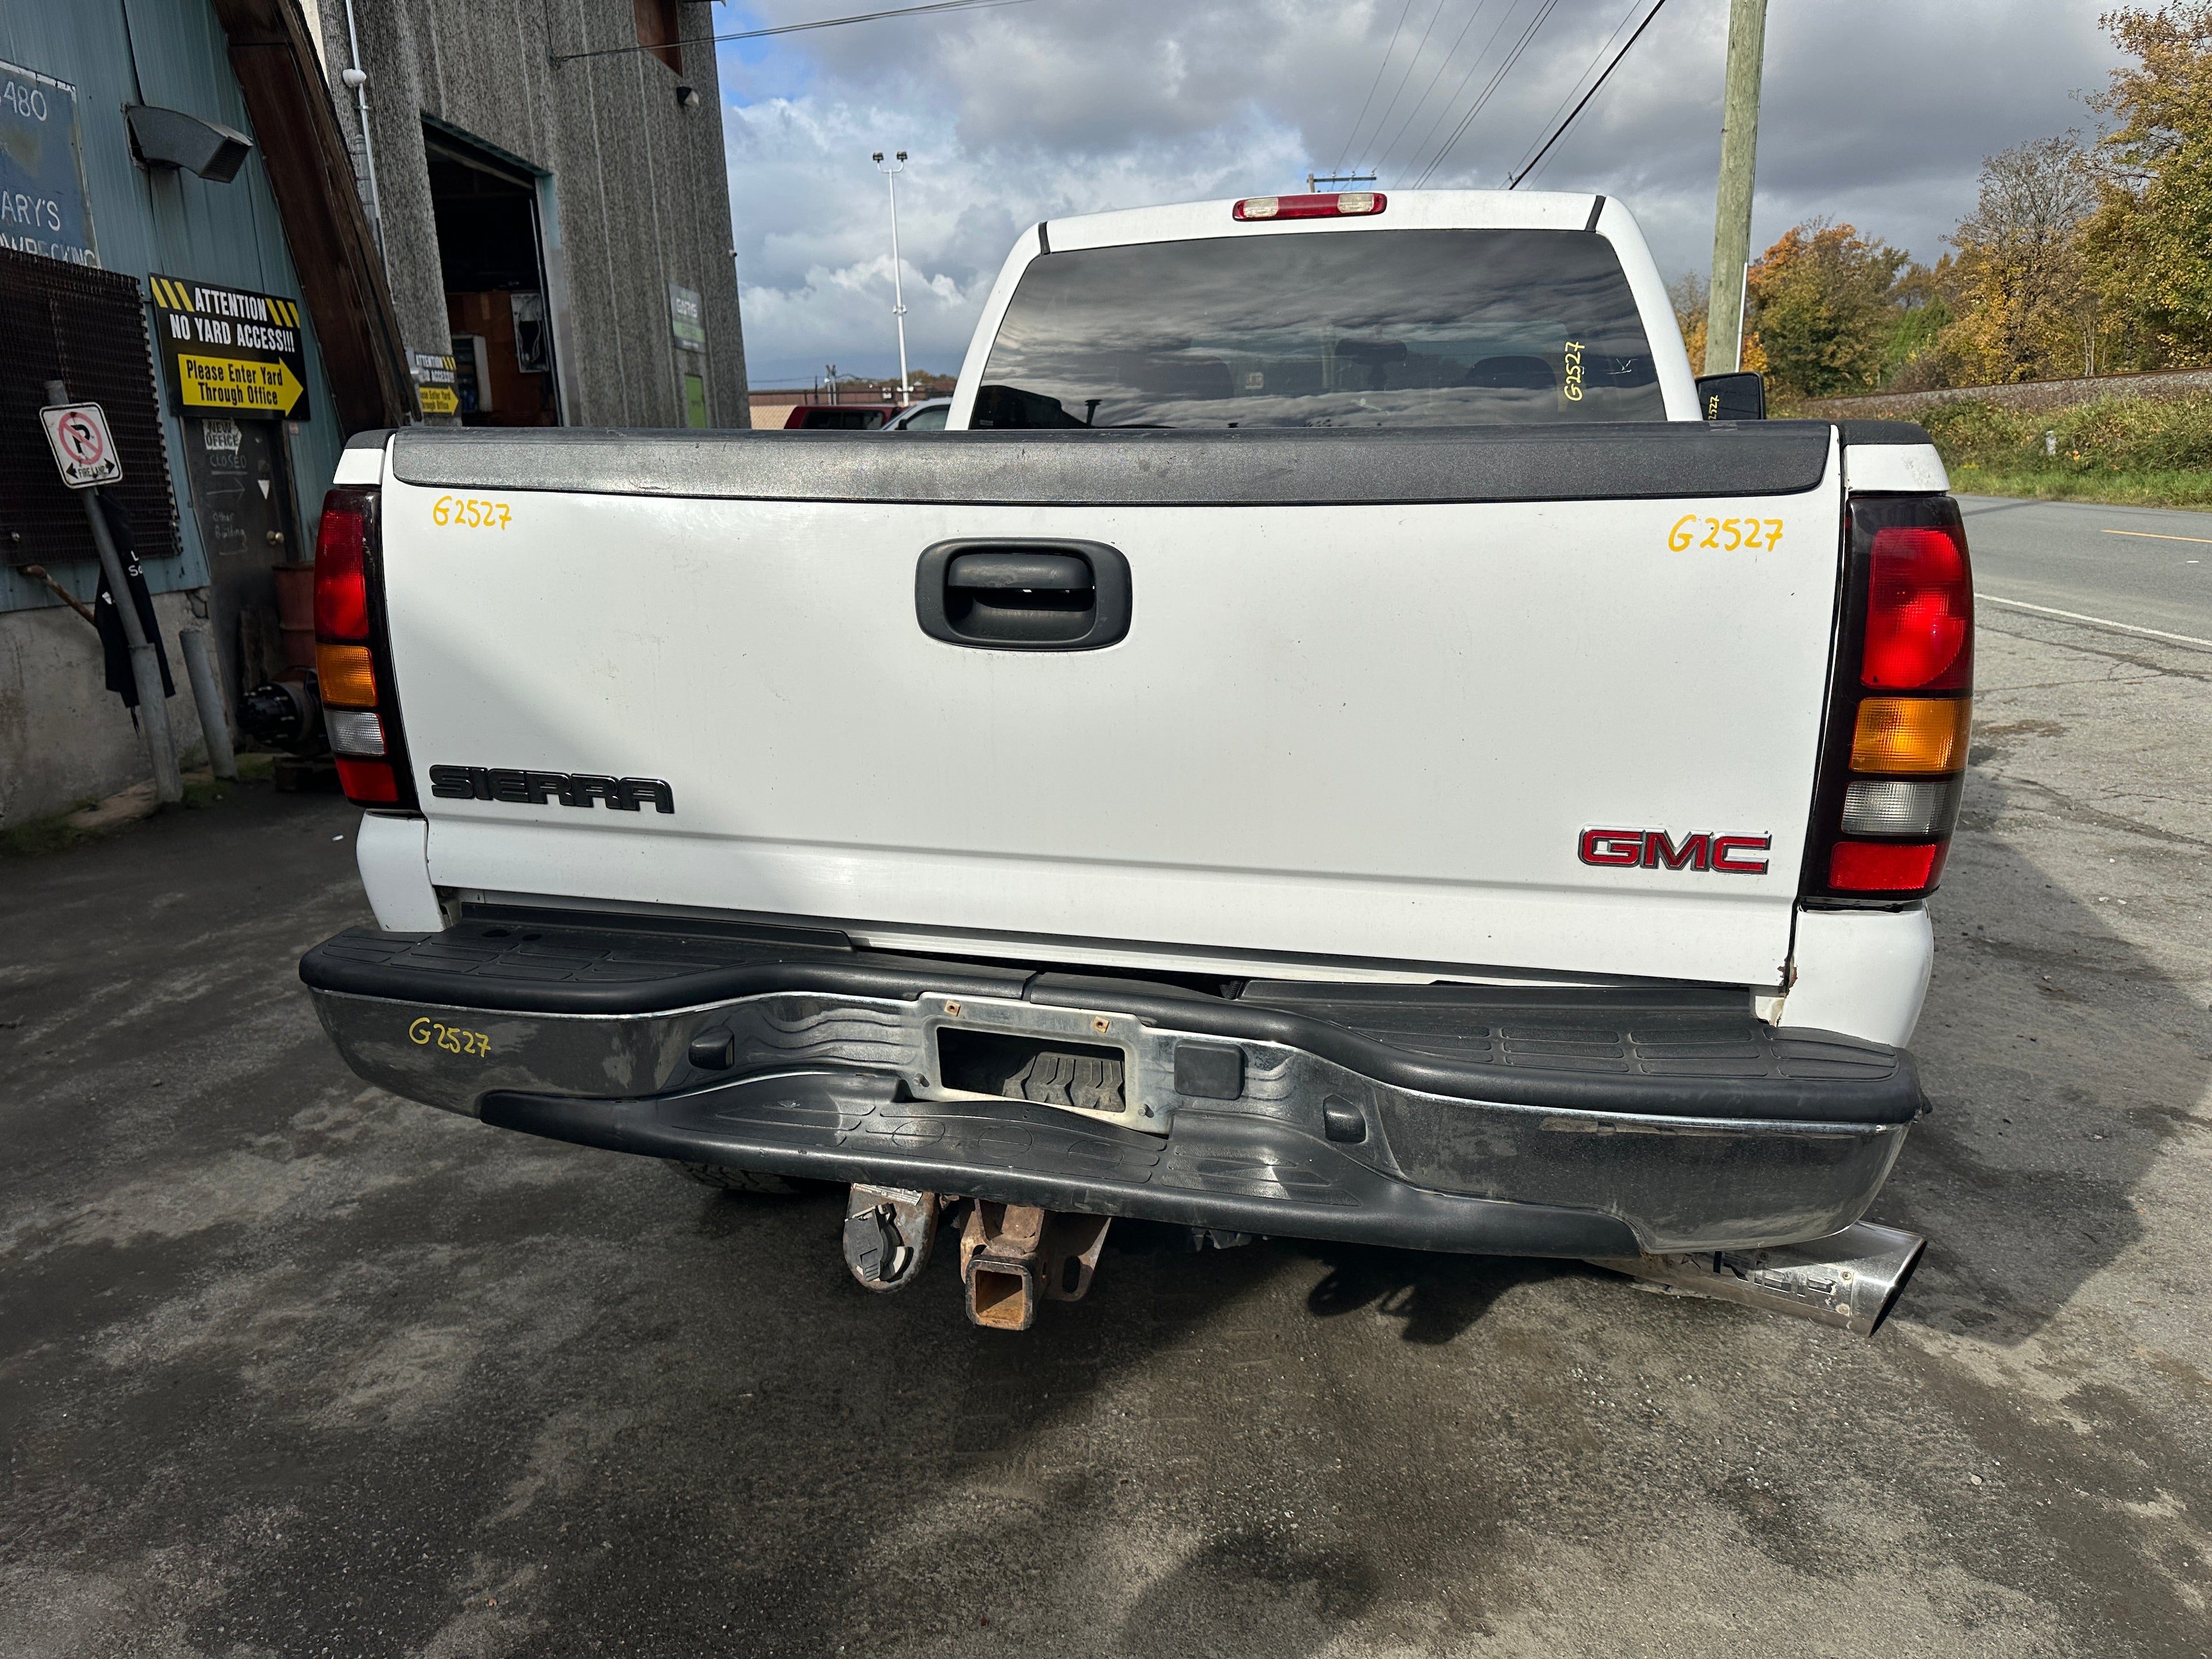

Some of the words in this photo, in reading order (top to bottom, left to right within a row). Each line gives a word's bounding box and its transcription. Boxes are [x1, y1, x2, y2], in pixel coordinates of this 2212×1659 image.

[0, 81, 47, 122] 480
[195, 287, 268, 321] ATTENTION
[169, 313, 191, 341] NO
[194, 317, 231, 345] YARD
[237, 323, 295, 353] ACCESS!!!
[186, 359, 224, 381] Please
[228, 363, 256, 384] Enter
[260, 366, 283, 386] Yard
[1564, 342, 1585, 401] G2527
[198, 382, 243, 406] Through
[247, 387, 278, 405] Office
[206, 432, 238, 446] OFFICE
[210, 453, 247, 468] CLOSED
[433, 495, 512, 531] G2527
[1668, 514, 1783, 552] G2527
[429, 764, 675, 814] SIERRA
[1577, 824, 1772, 875] GMC
[409, 1017, 491, 1058] G2527
